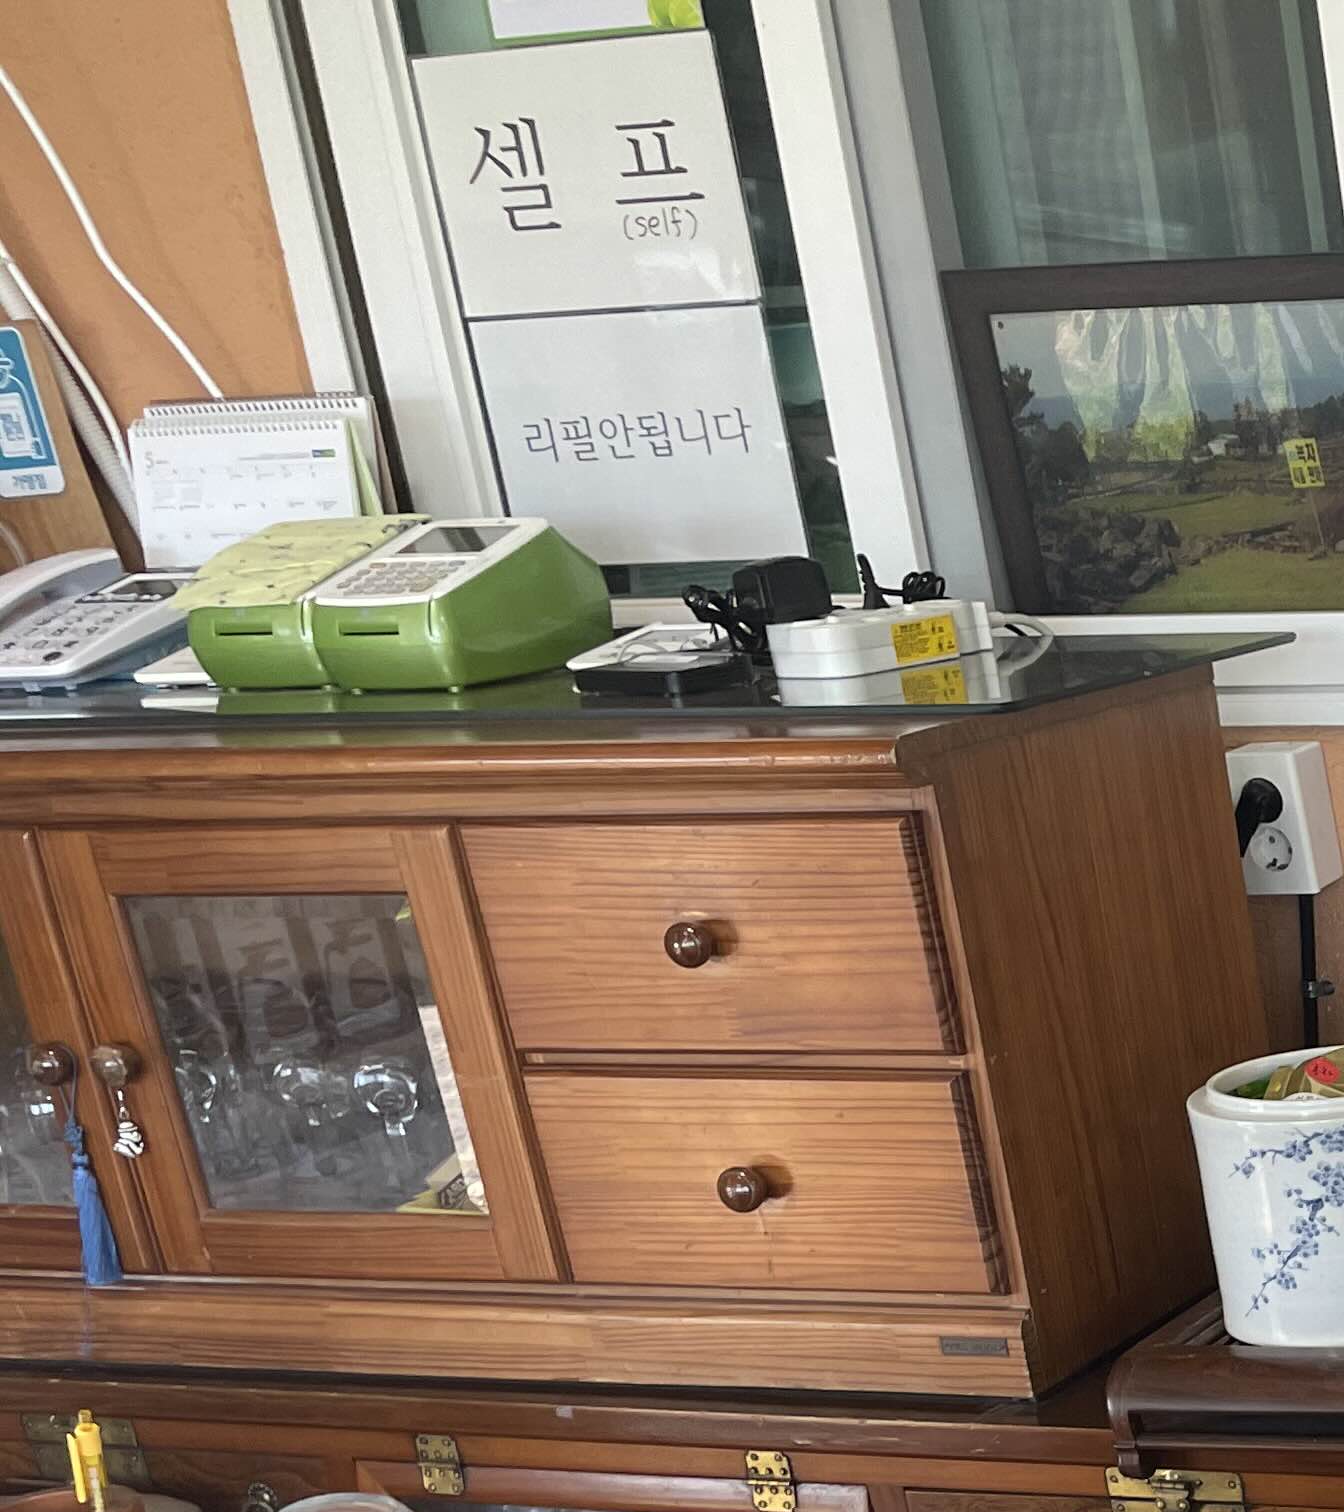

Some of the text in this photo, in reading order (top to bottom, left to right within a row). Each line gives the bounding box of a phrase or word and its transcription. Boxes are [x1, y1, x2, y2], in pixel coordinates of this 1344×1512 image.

[469, 116, 706, 231] 셀 프
[622, 205, 698, 241] (self)
